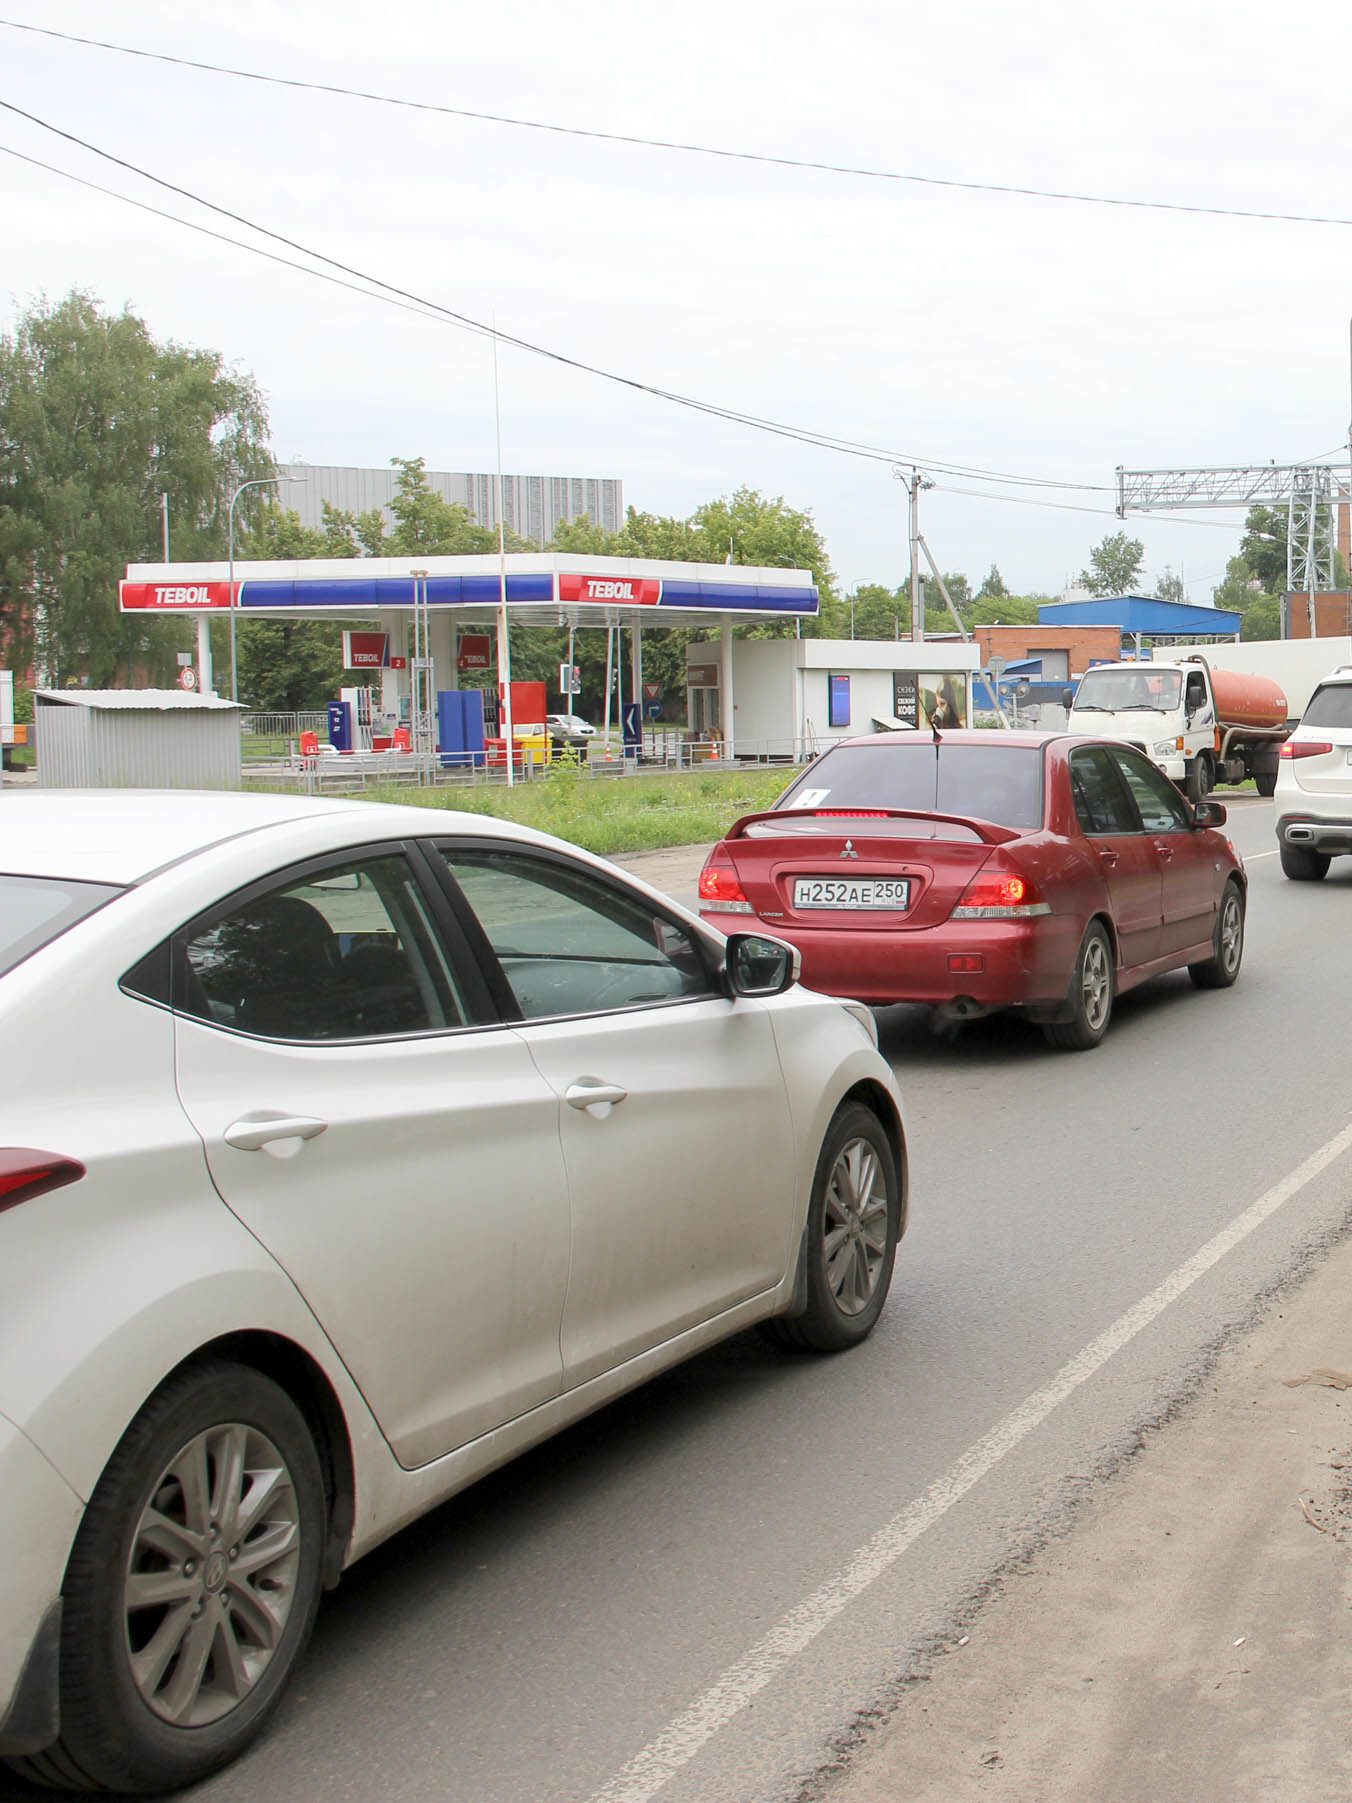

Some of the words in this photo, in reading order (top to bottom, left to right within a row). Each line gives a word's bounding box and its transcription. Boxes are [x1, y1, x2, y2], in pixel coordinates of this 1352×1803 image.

[154, 586, 212, 604] TEBOIL
[587, 580, 634, 600] TEBOIL
[353, 653, 379, 663] TEBOIL
[897, 705, 915, 715] КОФЕ
[800, 883, 871, 903] Н252АЕ
[875, 883, 904, 898] 250
